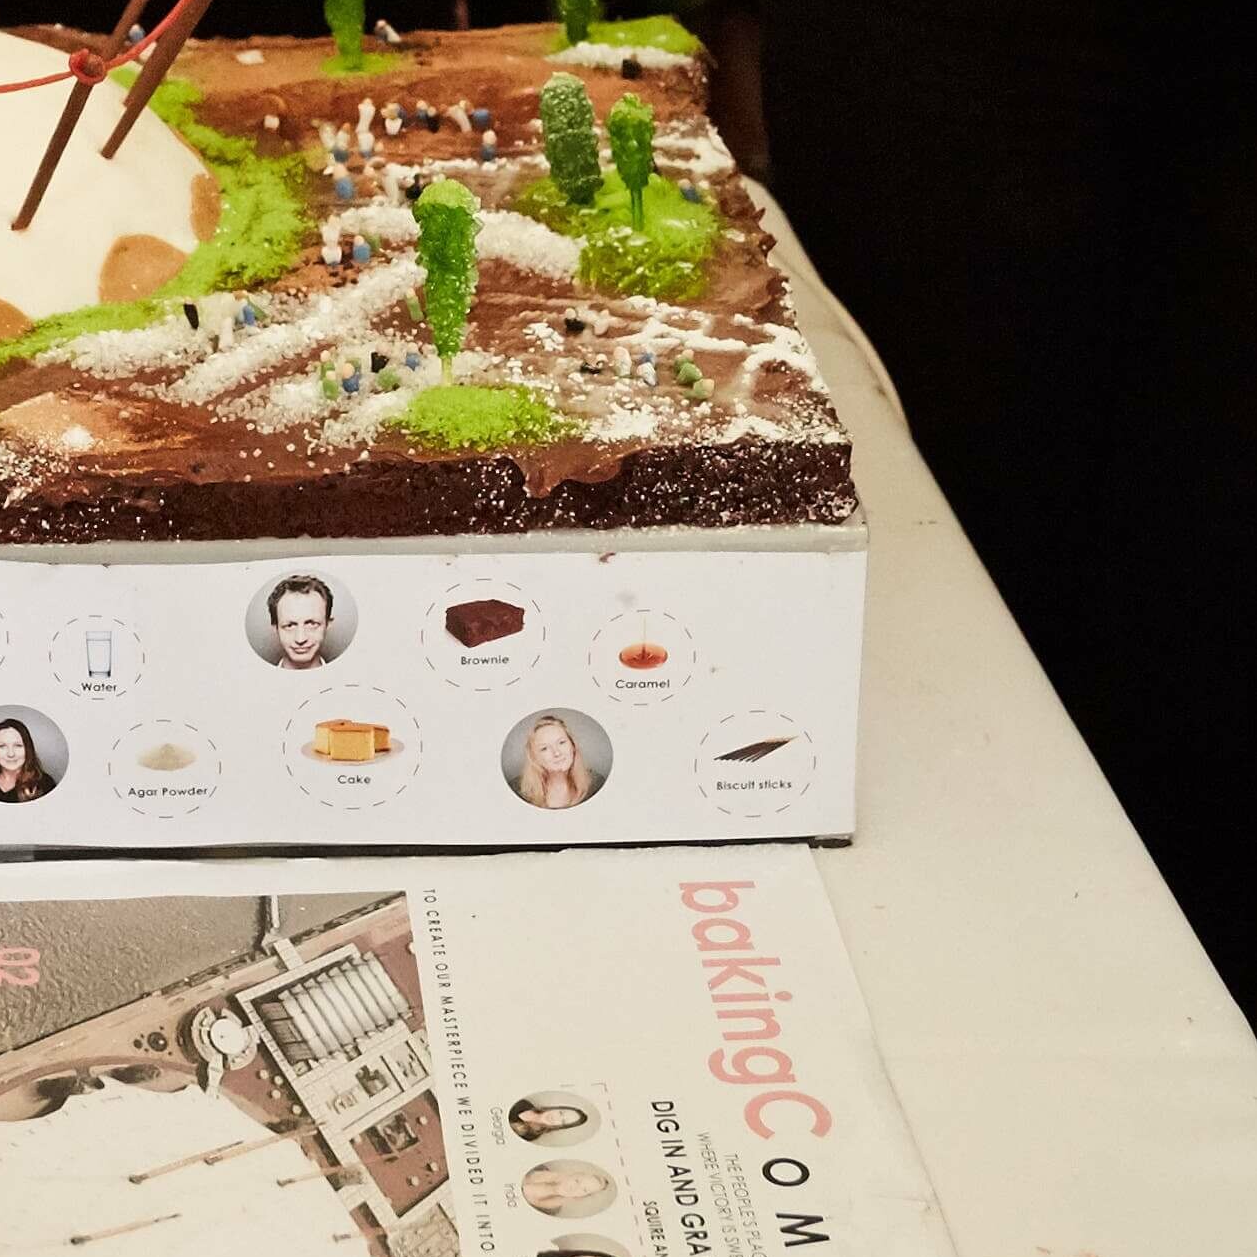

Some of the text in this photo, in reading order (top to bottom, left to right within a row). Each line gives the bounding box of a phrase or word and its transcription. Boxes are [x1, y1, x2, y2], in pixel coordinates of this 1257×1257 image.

[459, 654, 510, 666] Brownie
[81, 681, 118, 693] Water
[615, 678, 671, 690] Caramel
[337, 773, 372, 785] Cake
[716, 779, 793, 791] Biscuit sticks
[127, 785, 209, 800] Agar Powder
[422, 889, 495, 1252] TO CREATE OUR MASTERPIECE WE DIVIDED IT INTO
[723, 1153, 742, 1173] THE
[651, 1101, 711, 1256] DIG IN AND GRA
[697, 1132, 719, 1170] WHERE
[709, 1173, 733, 1221] VICTORY
[721, 1225, 737, 1234] IS
[731, 1175, 758, 1227] PEOPLE'S
[643, 1201, 666, 1241] SQUIRE
